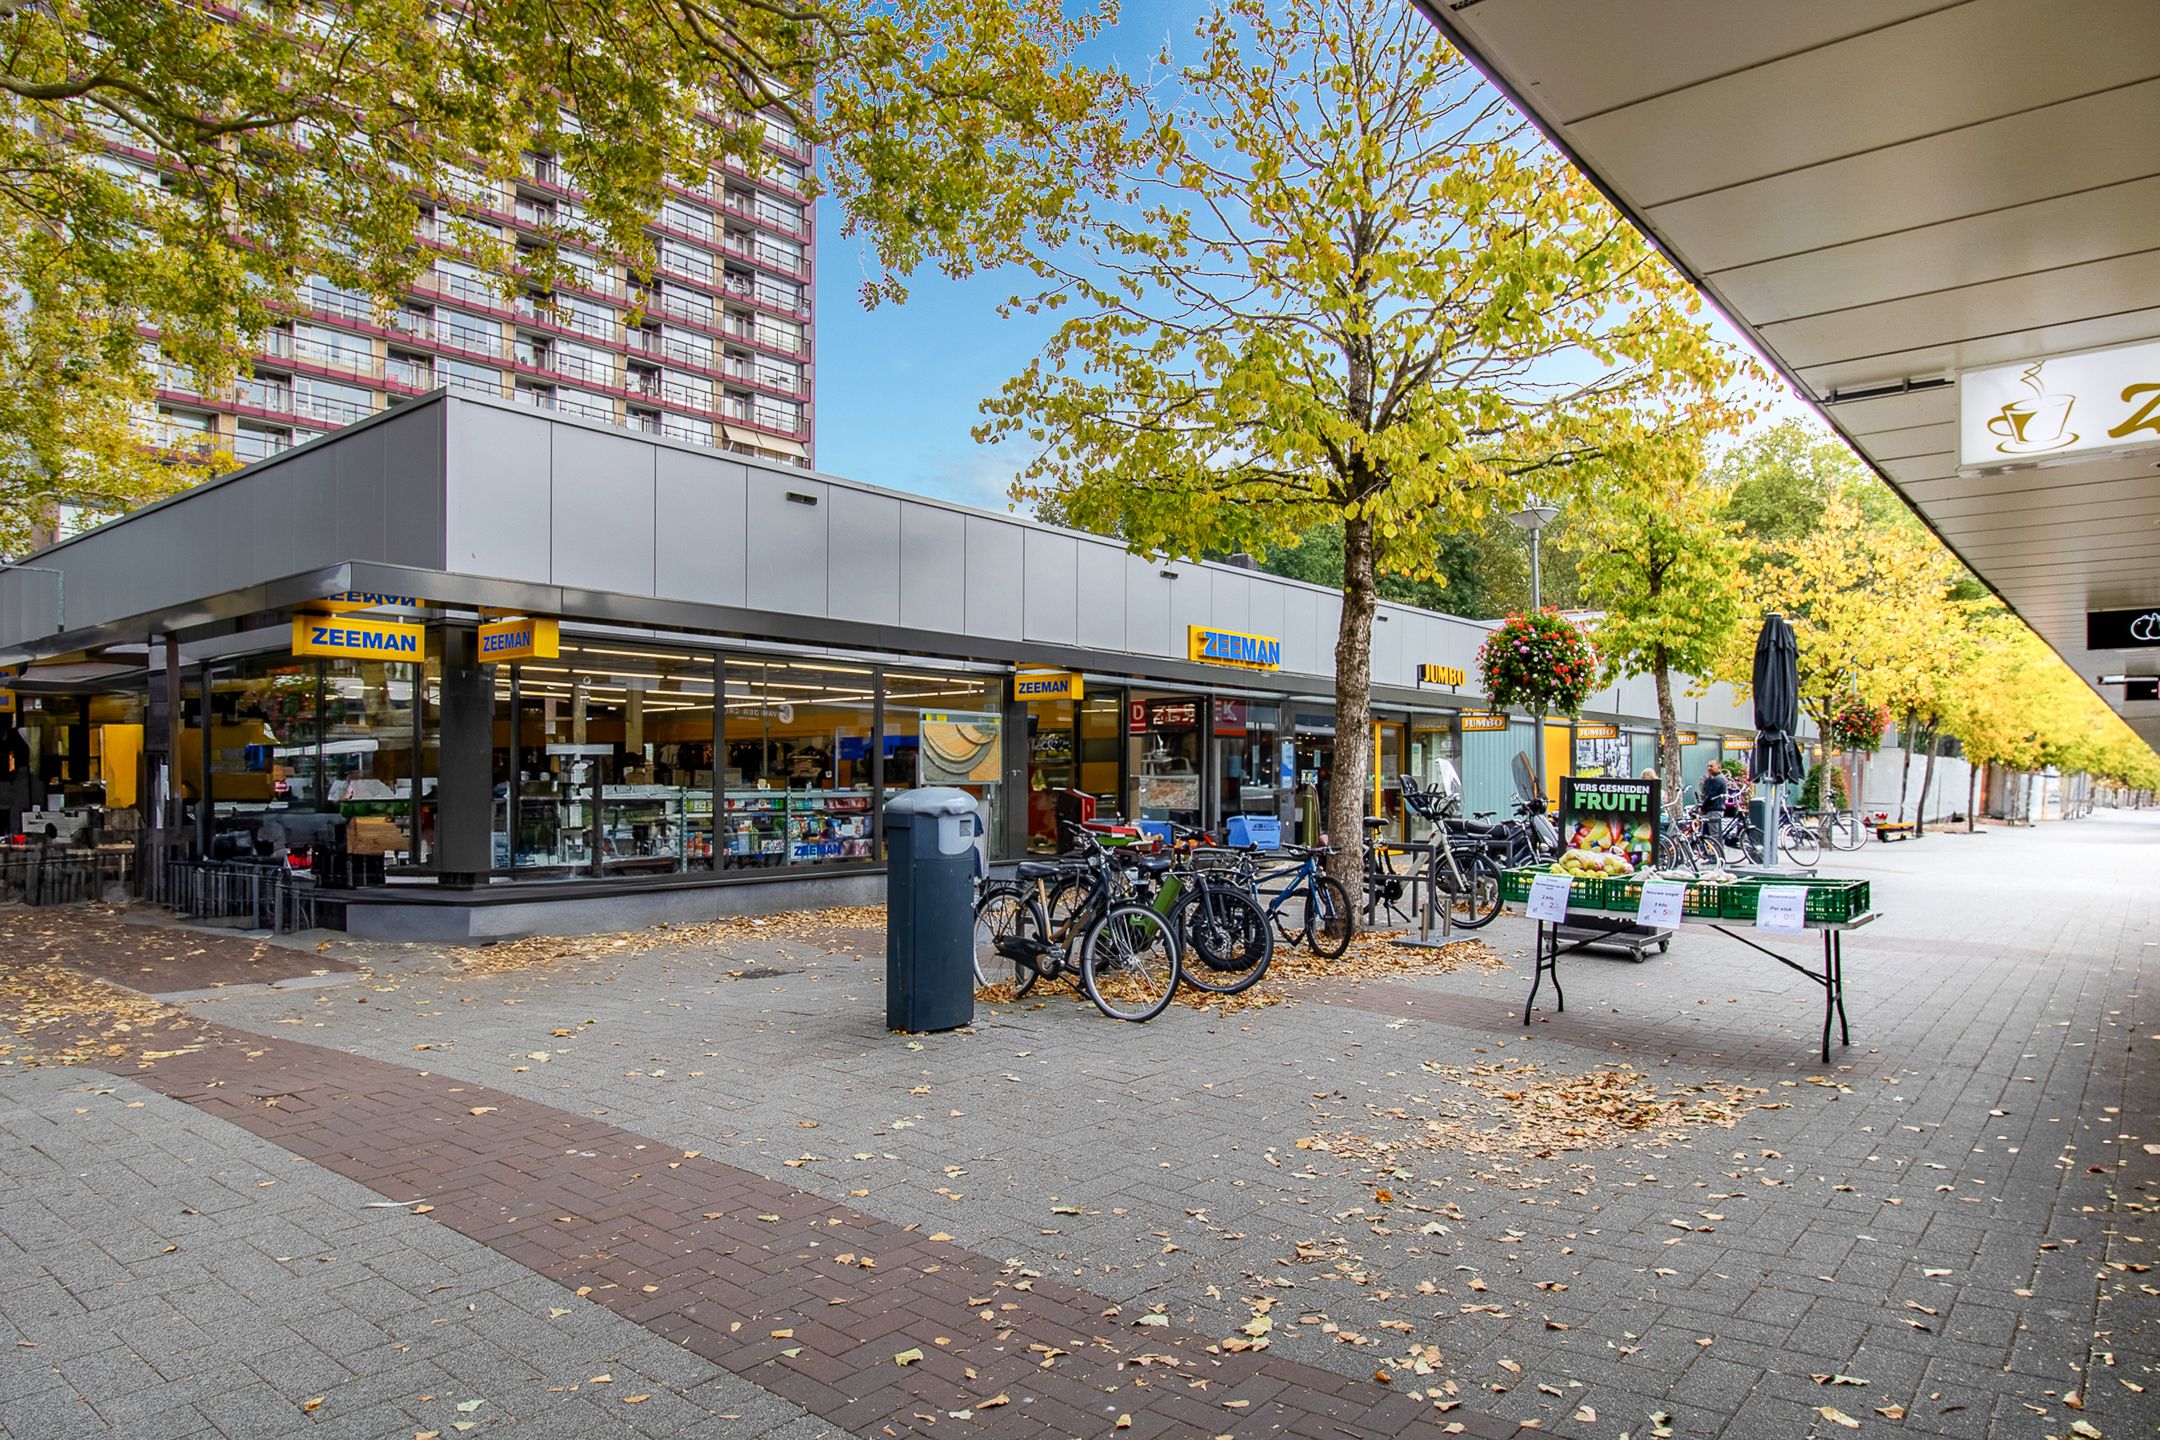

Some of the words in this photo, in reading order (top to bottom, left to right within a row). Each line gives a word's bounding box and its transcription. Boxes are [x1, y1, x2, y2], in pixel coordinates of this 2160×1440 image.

[312, 627, 416, 652] ZEEMAN
[483, 631, 531, 652] ZEEMAN
[1203, 631, 1280, 665] ZEEMAN
[1424, 664, 1466, 686] JUMBO
[1018, 680, 1068, 694] ZEEMAN
[1464, 718, 1503, 728] JUMBO
[1579, 728, 1615, 737] JUMBO
[1574, 783, 1598, 792] VERS
[1599, 784, 1650, 794] GESNEDEN
[1574, 792, 1648, 812] FRUIT!
